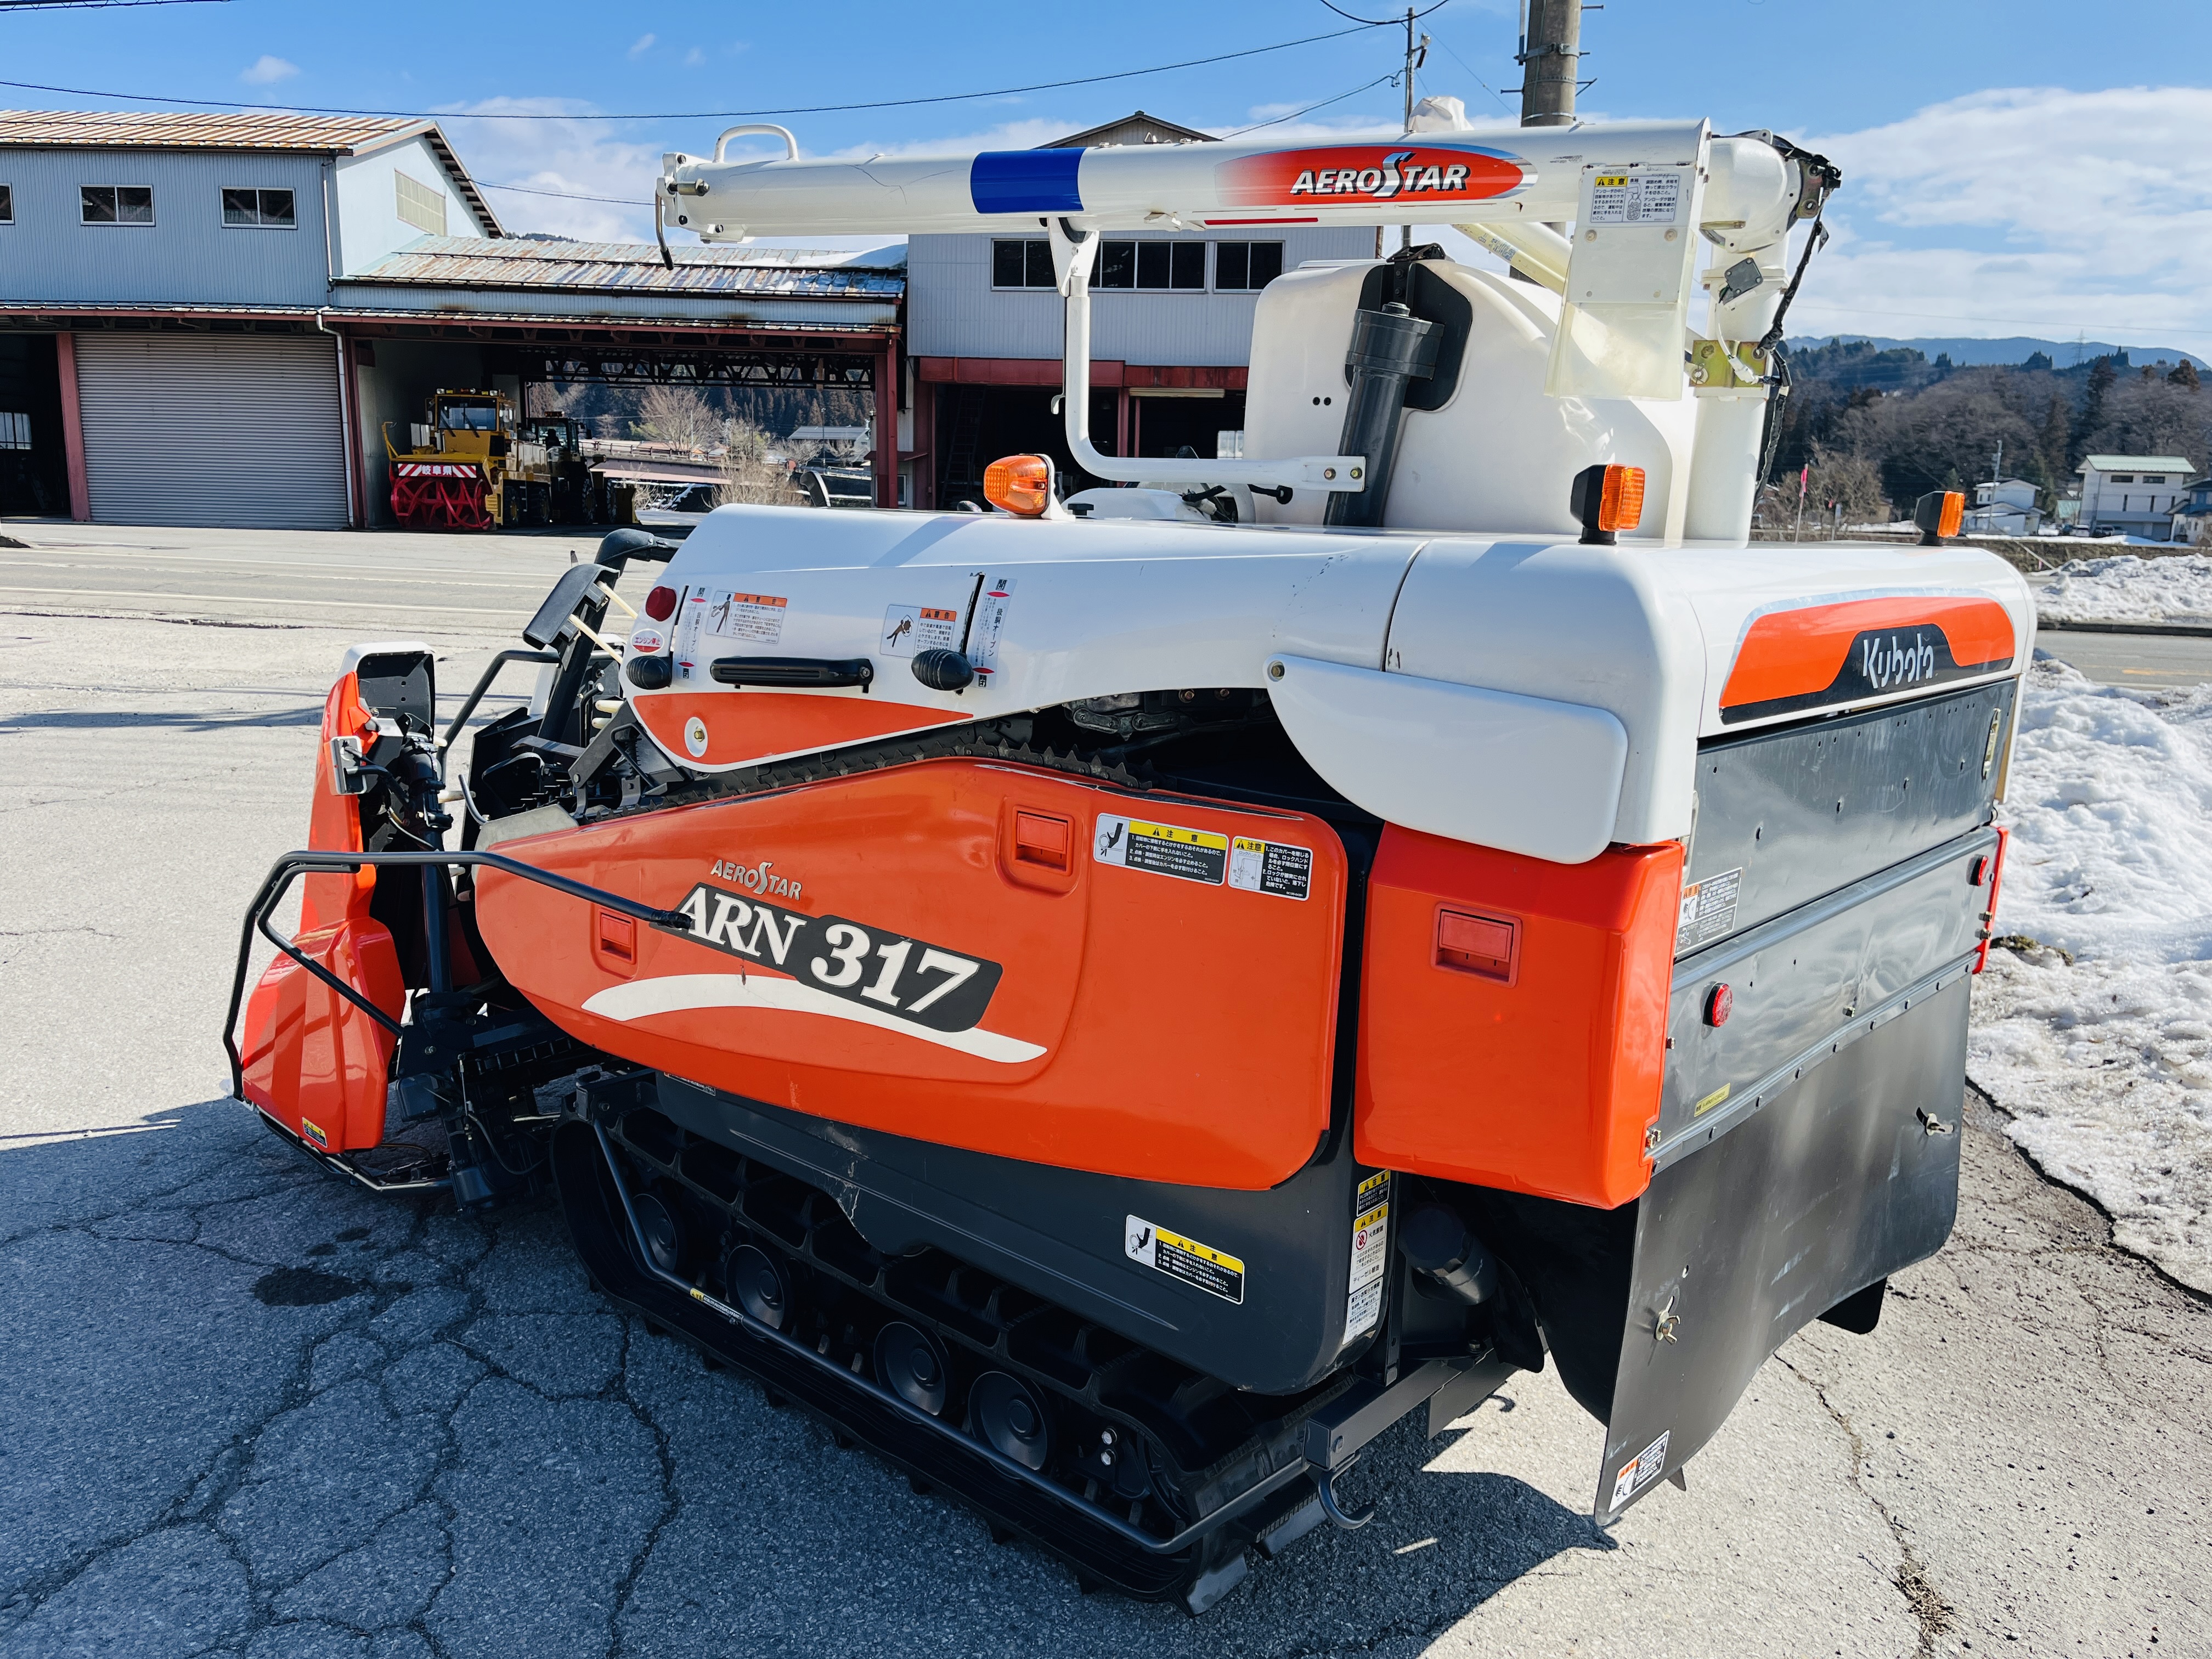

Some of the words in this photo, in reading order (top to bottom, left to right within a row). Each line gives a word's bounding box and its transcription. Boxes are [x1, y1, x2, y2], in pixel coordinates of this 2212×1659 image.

[1290, 151, 1471, 198] AEROSTAR
[422, 465, 452, 475] 岐阜県
[934, 611, 950, 619] 警告
[634, 637, 661, 646] エンジン停止
[1863, 633, 1934, 689] Kubota
[1166, 830, 1198, 843] 注意
[1247, 842, 1262, 851] 注意
[710, 860, 803, 900] AEROSTAR
[676, 887, 808, 966] ARN
[810, 924, 981, 1014] 317
[1189, 1244, 1217, 1261] 注意
